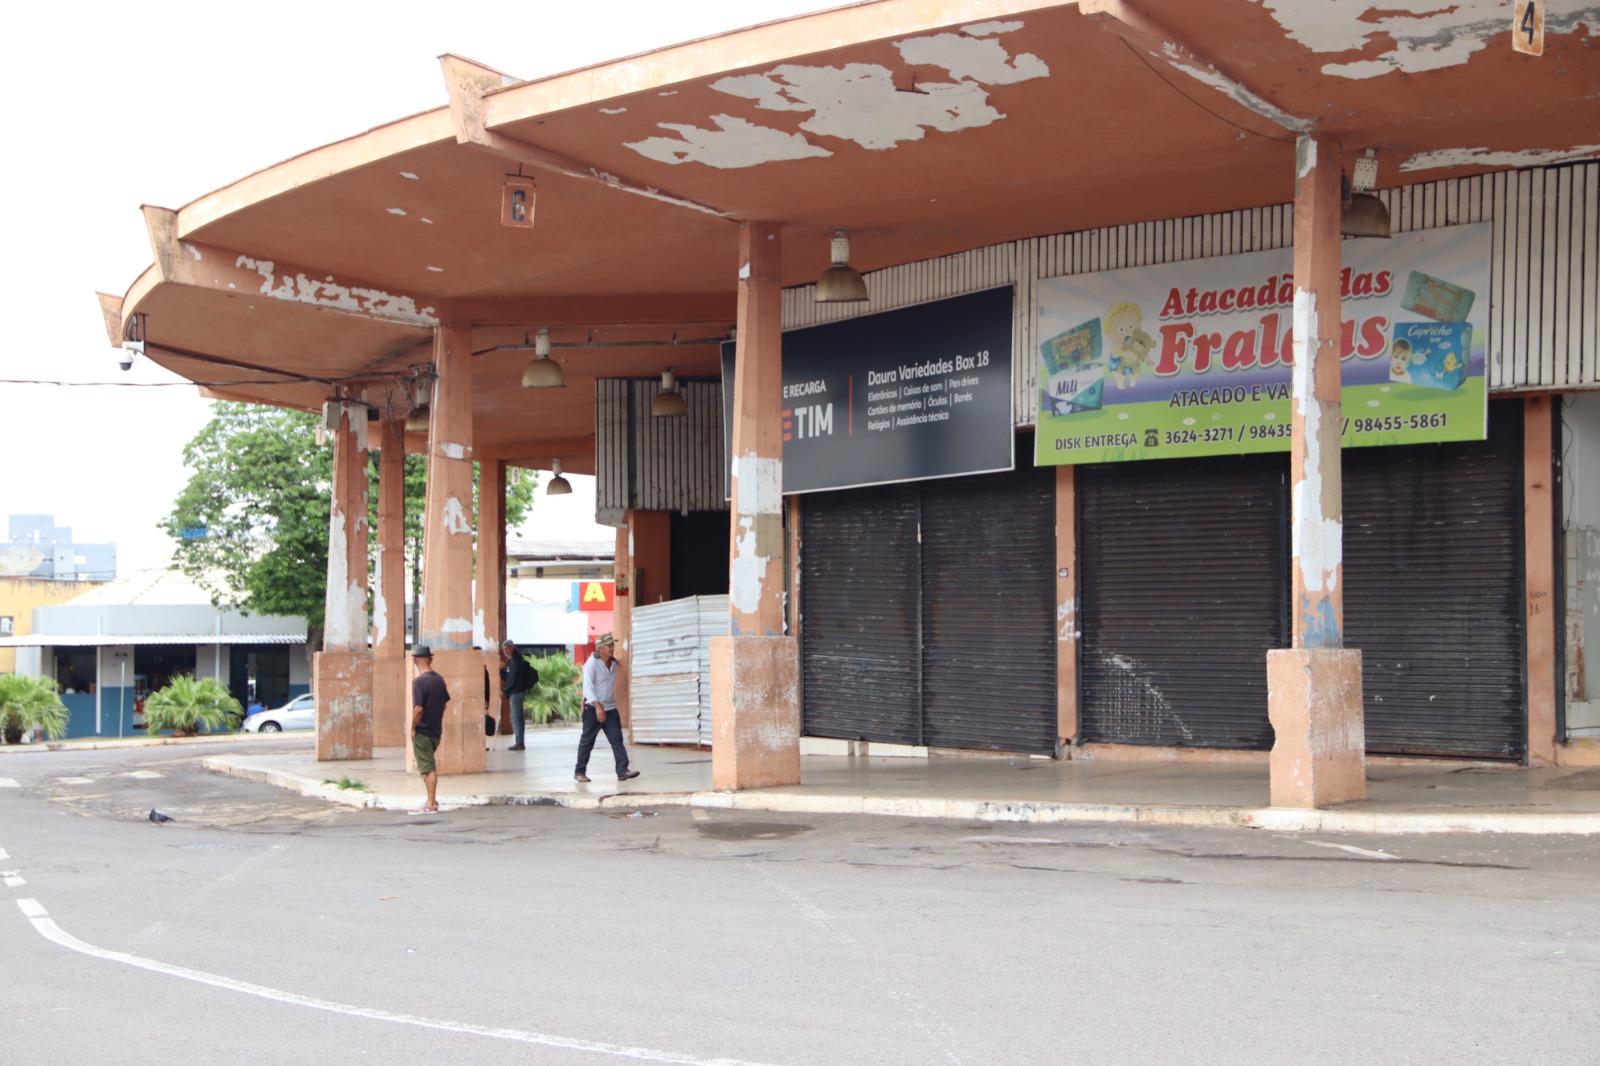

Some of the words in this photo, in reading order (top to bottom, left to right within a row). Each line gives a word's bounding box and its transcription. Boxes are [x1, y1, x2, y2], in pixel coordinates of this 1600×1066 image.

[1520, 1, 1535, 46] 4
[1159, 274, 1293, 317] Atacadã
[1407, 324, 1453, 339] Capricho
[868, 370, 897, 386] Daura
[898, 358, 954, 381] Variedades
[955, 354, 976, 371] Box
[976, 350, 990, 368] 18
[783, 385, 789, 399] E
[789, 379, 827, 398] RECARGA
[867, 389, 898, 402] Eletrônicos
[903, 385, 922, 397] Caixas
[921, 383, 930, 394] de
[930, 382, 943, 393] som
[949, 378, 961, 389] Pen
[961, 376, 979, 388] drives
[1168, 387, 1246, 409] ATACADO
[1251, 386, 1262, 402] E
[867, 405, 889, 416] Cartões
[888, 404, 897, 413] de
[896, 399, 922, 412] memória
[954, 392, 973, 404] Bonés
[794, 402, 833, 440] TIM
[896, 413, 928, 427] Assistência
[928, 410, 949, 422] técnica
[1055, 437, 1082, 451] DISK
[1085, 433, 1138, 449] ENTREGA
[1165, 427, 1233, 445] 3624-3271
[1354, 412, 1447, 433] 98455-5861
